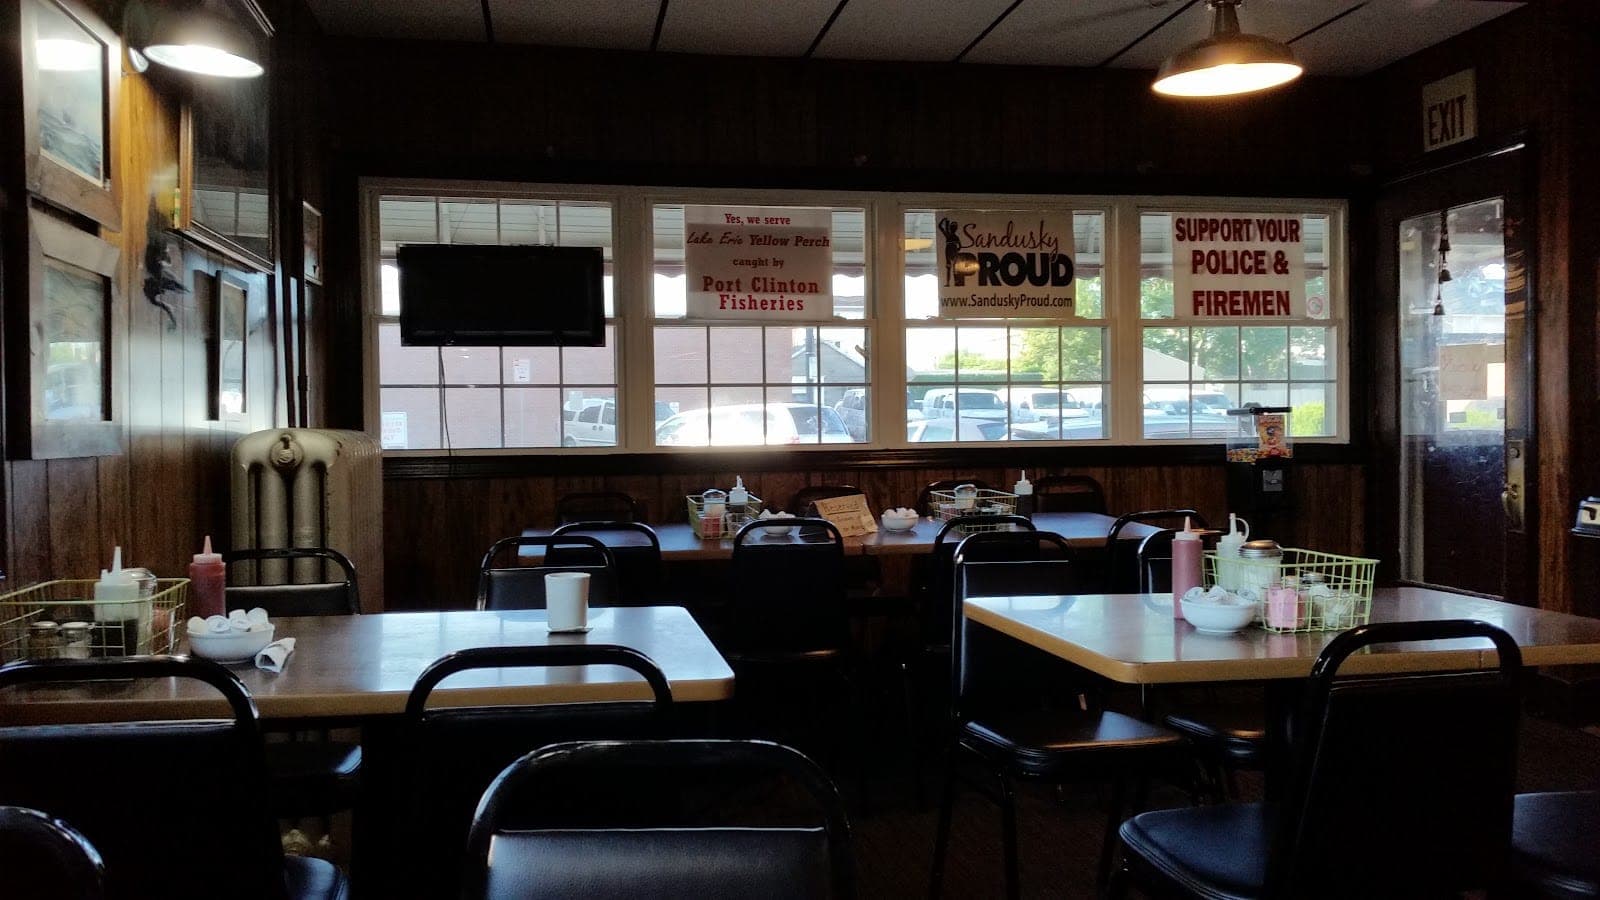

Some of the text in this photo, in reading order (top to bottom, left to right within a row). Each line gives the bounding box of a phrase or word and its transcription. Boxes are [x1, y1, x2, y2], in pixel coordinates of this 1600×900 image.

[1428, 95, 1466, 145] EXIT
[725, 213, 791, 225] Yes, we serve
[1175, 217, 1300, 242] SUPPORT YOUR
[750, 234, 790, 246] Yellow
[794, 235, 830, 247] Perch
[959, 220, 1058, 261] Sandusky
[733, 257, 784, 268] caught by
[954, 252, 1074, 287] PROUD
[1191, 249, 1290, 275] POLICE &
[703, 275, 819, 293] Port Clinton
[719, 294, 804, 311] Fisheries
[942, 294, 1072, 310] www.SanduskyProud.com
[1192, 290, 1291, 316] FIREMEN
